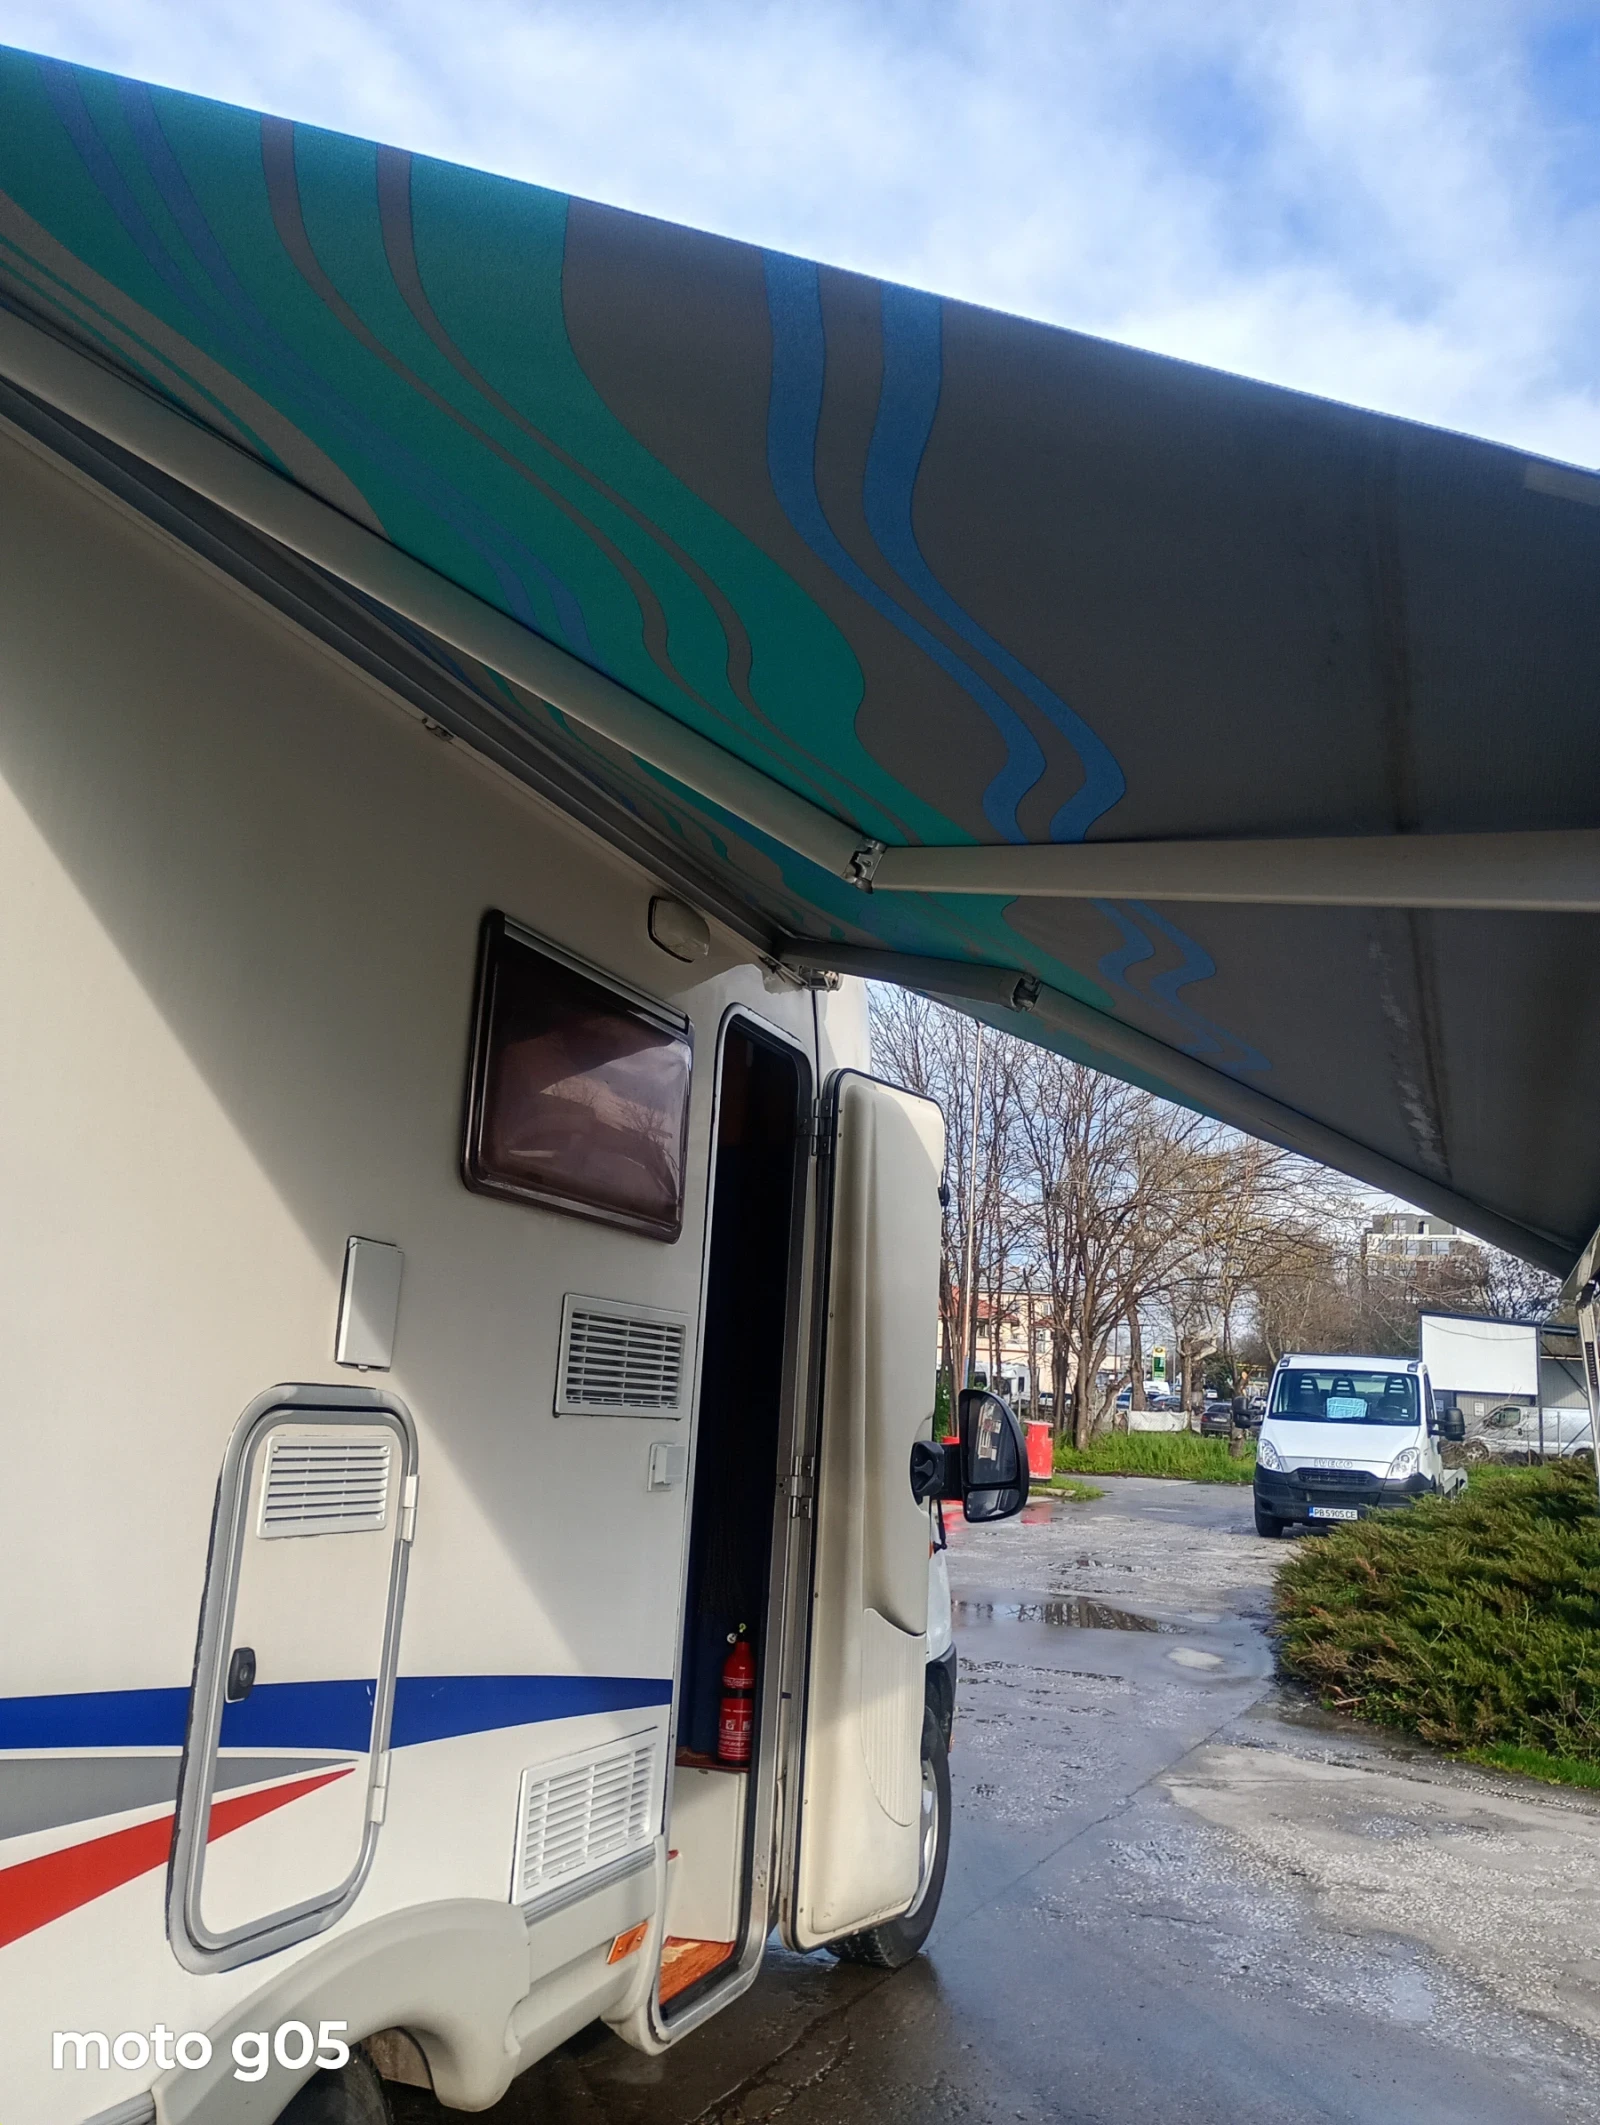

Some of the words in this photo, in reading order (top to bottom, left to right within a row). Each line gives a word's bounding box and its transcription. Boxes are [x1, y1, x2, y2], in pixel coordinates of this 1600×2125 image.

[1313, 1459, 1353, 1469] IVECO
[1314, 1508, 1325, 1517] PB
[1345, 1510, 1356, 1519] CE
